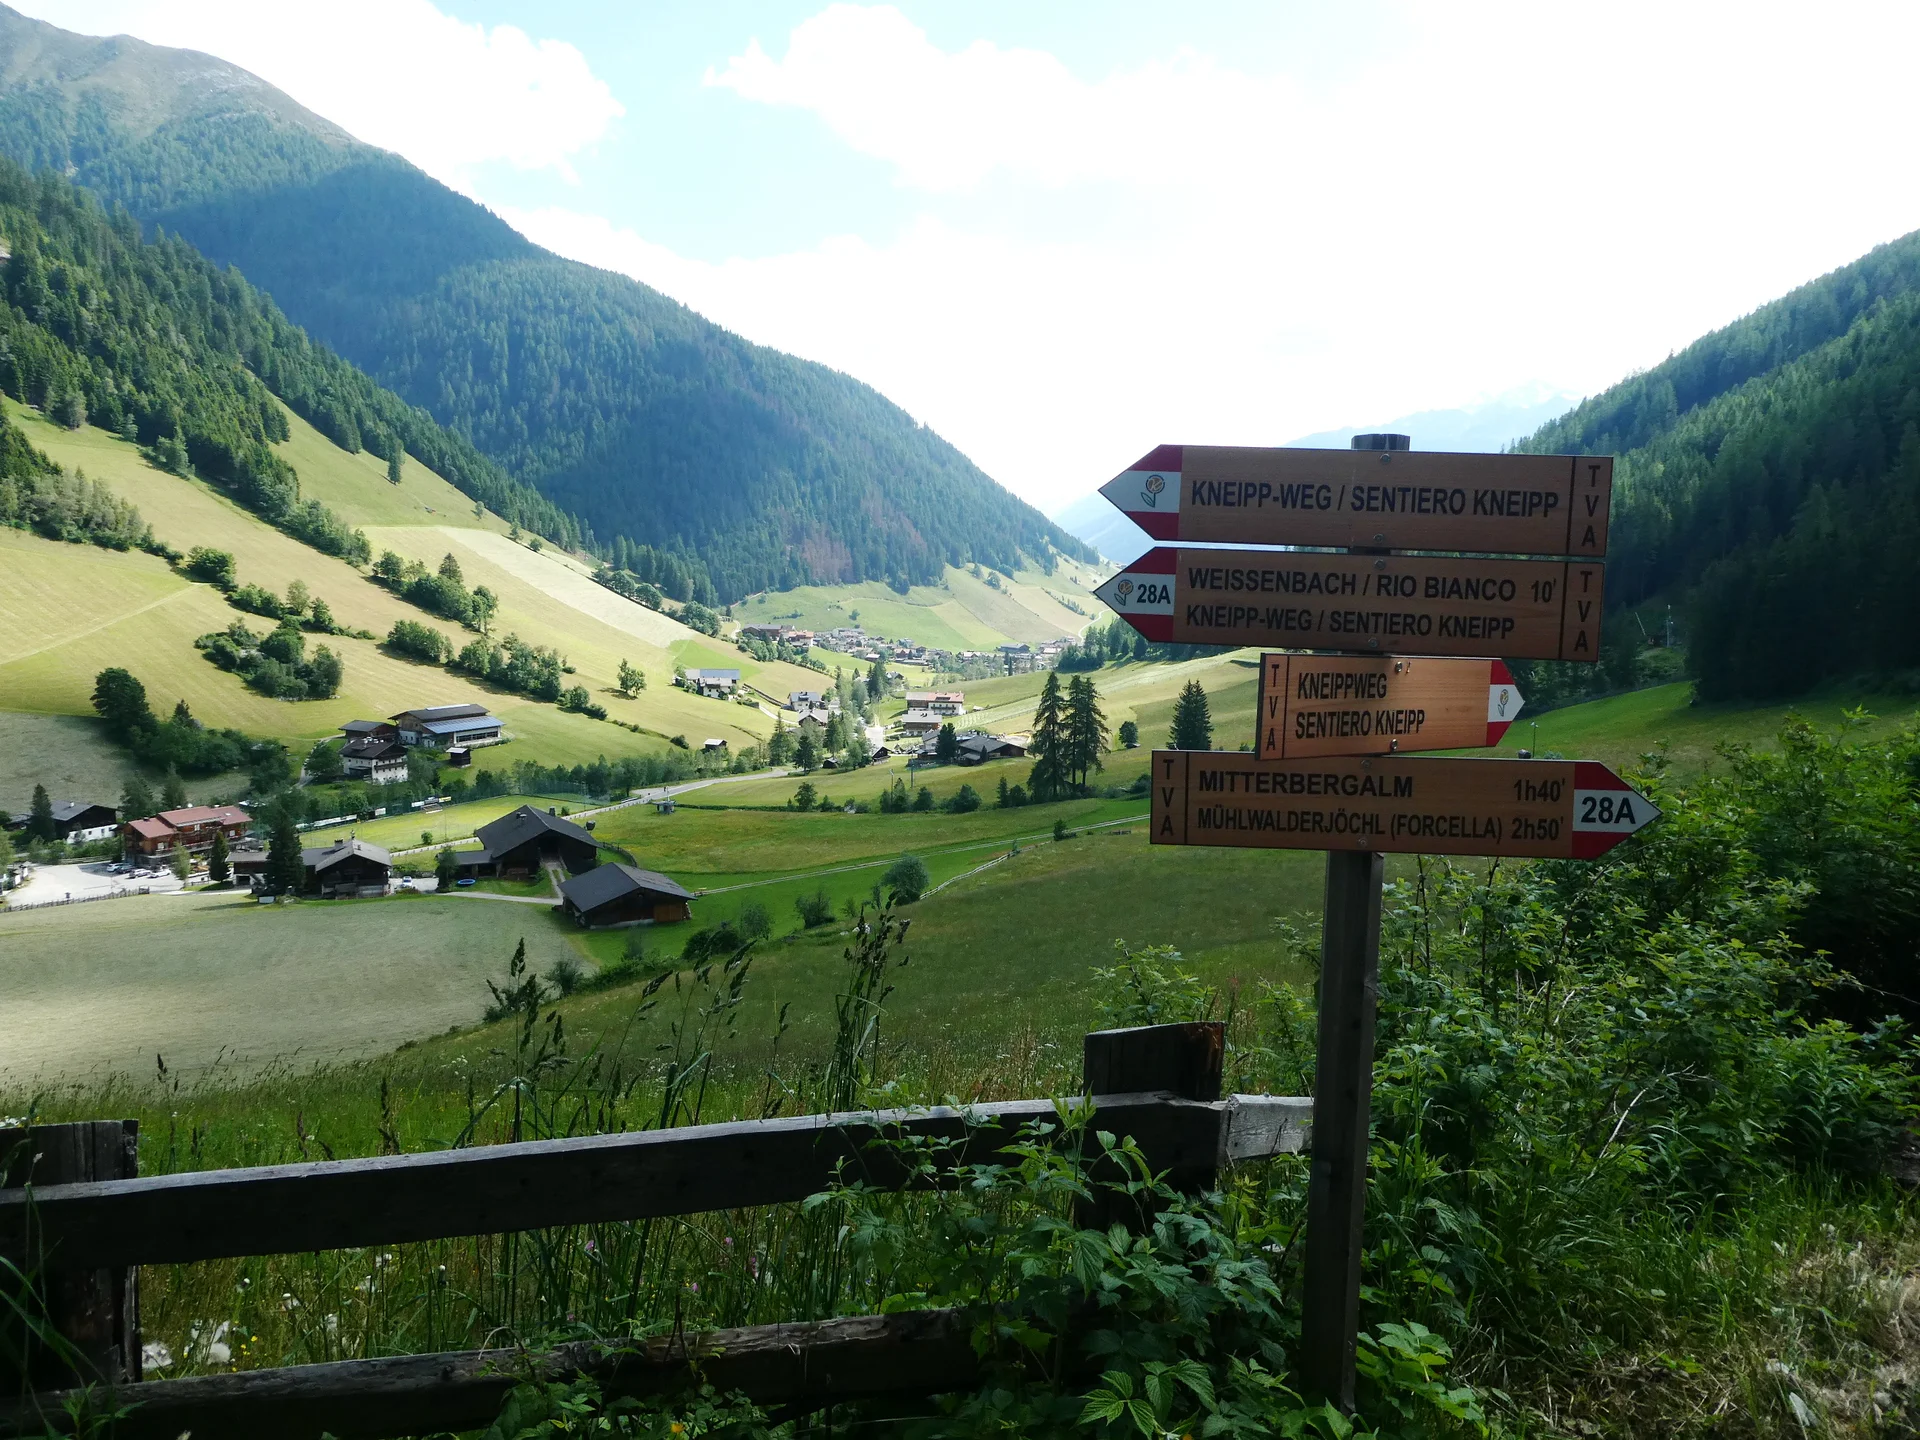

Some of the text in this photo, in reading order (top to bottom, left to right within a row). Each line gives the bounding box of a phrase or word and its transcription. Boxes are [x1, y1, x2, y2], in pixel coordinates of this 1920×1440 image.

[1191, 480, 1559, 518] KNEIPP-WEG / SENTIERO KNEIPP
[1136, 584, 1171, 604] 28A
[1188, 567, 1557, 603] WEISSENBACH / RIO BIANCO 10'
[1186, 604, 1515, 640] KNEIPP-WEG / SENTIERO KNEIPP
[1298, 672, 1387, 699] KNEIPPWEG
[1295, 709, 1425, 739] SENTIERO KNEIPP
[1199, 770, 1566, 802] MITTERBERGALM 1h40'
[1197, 804, 1564, 844] MÜHLWALDERJÖCHL (FORCELLA) 2h50'
[1581, 796, 1636, 825] 28A
